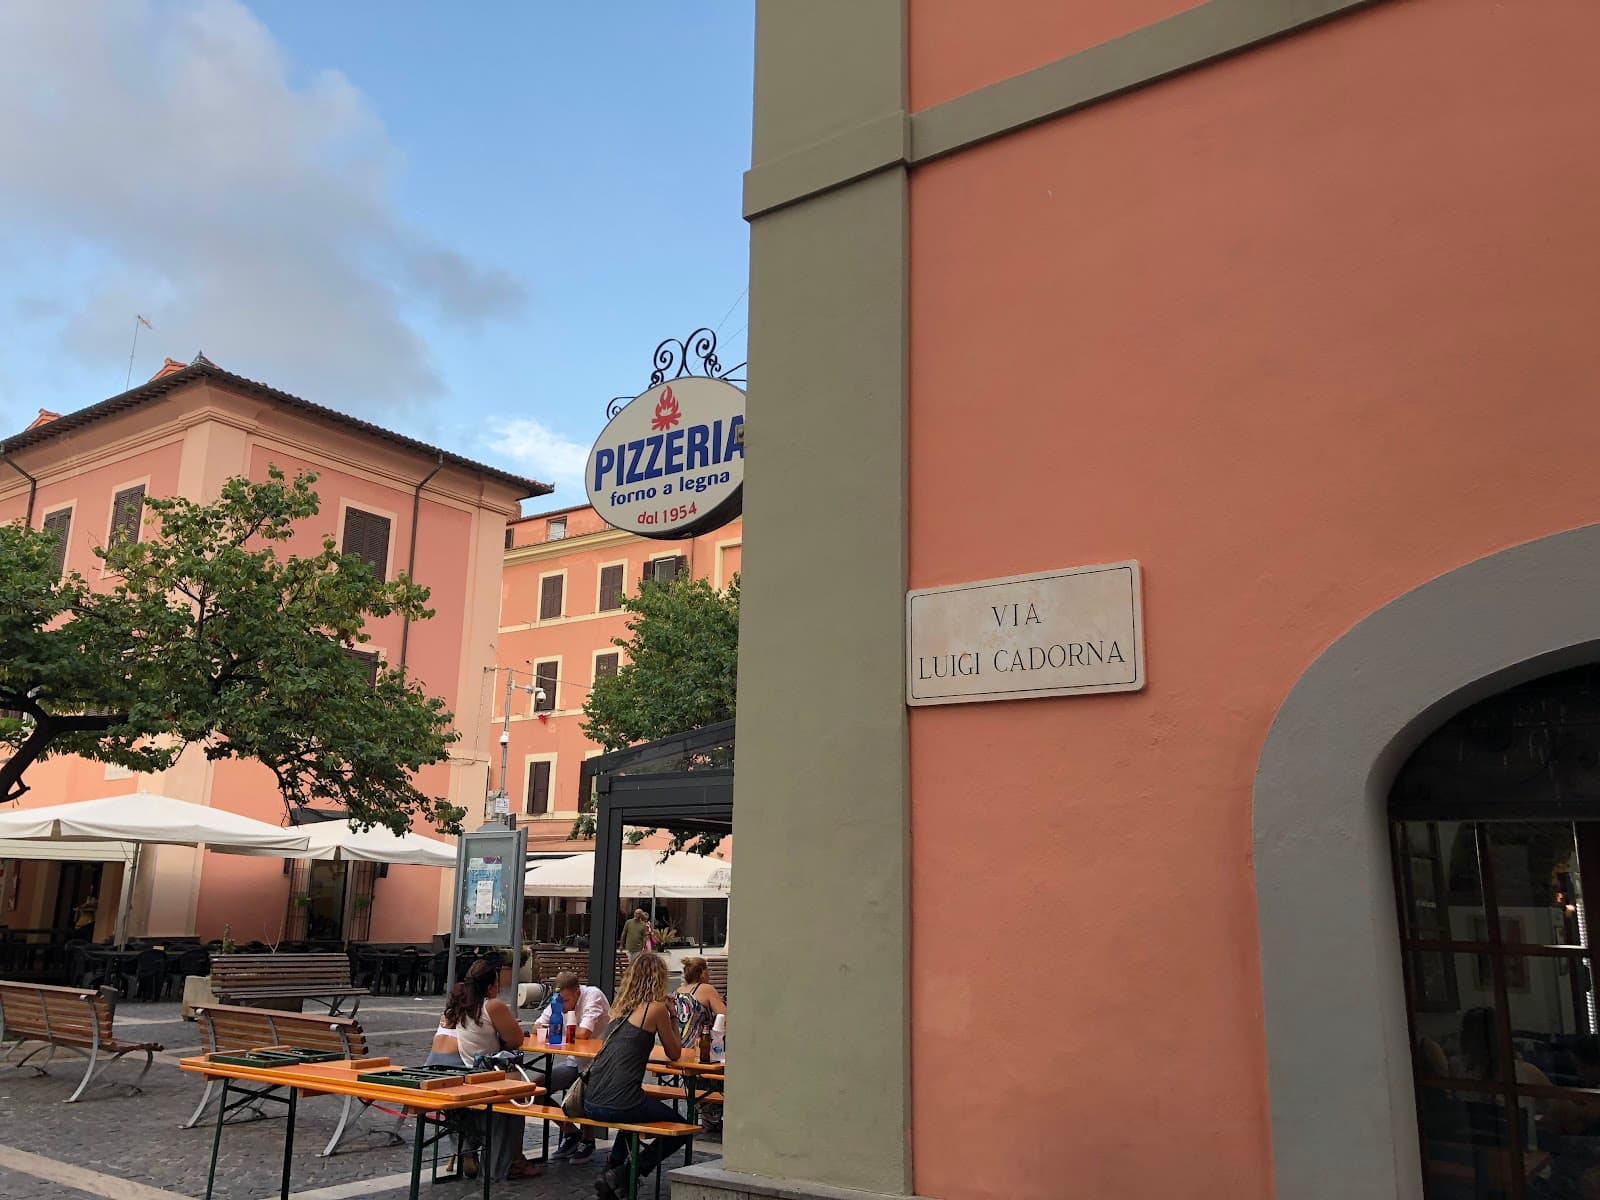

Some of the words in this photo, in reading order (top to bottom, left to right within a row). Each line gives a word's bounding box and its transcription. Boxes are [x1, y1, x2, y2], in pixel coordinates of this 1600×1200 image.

[594, 415, 745, 492] PIZZERIA
[610, 486, 657, 506] forno
[663, 483, 673, 495] a
[680, 471, 730, 492] legna
[637, 510, 658, 525] dal
[663, 501, 697, 523] 1954
[992, 602, 1042, 627] VIA
[919, 652, 981, 680] LUIGI
[993, 640, 1126, 673] CADORNA
